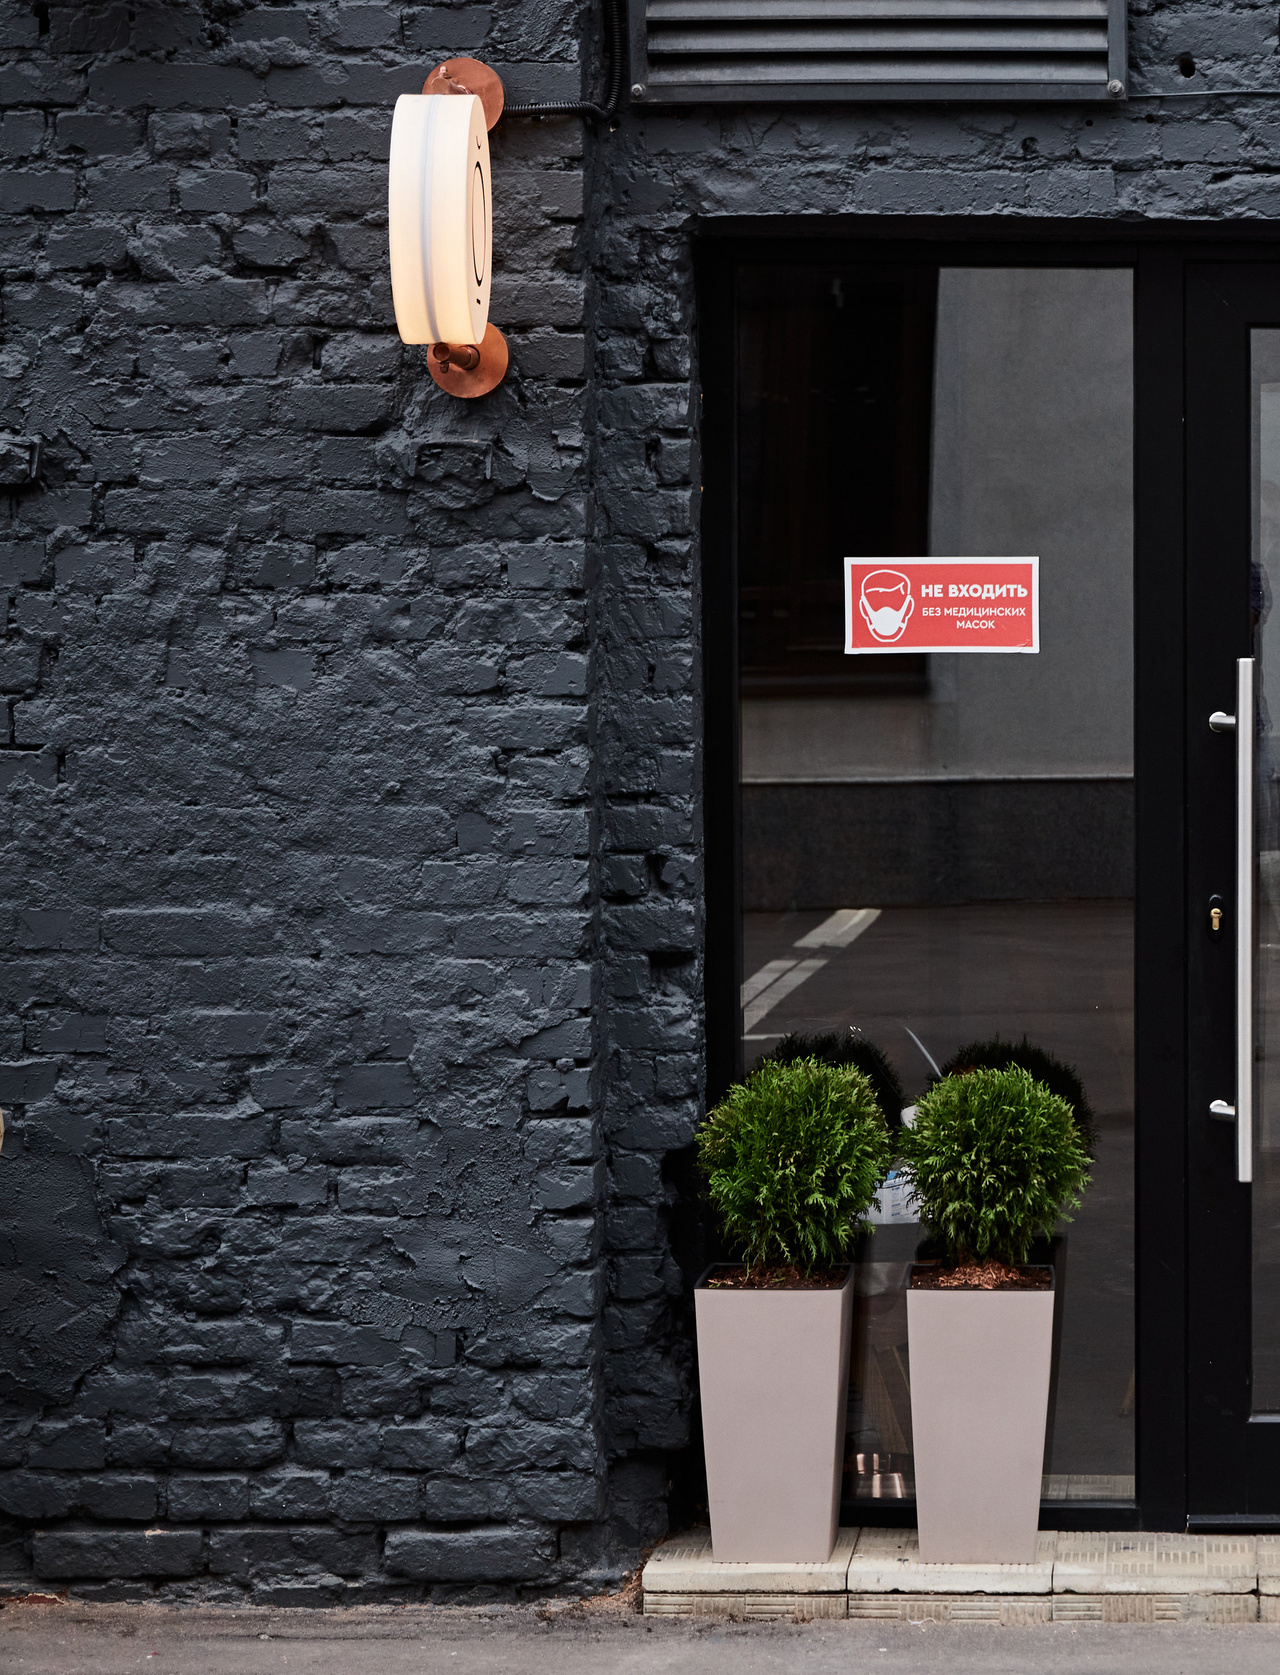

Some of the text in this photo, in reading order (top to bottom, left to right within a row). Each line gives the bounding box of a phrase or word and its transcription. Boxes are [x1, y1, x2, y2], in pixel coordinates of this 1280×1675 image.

[921, 584, 1028, 599] НЕ ВХОДИТЬ
[922, 607, 1026, 617] БЕЗ МЕДИЦИНСКИХ
[956, 620, 995, 629] МАСОК
